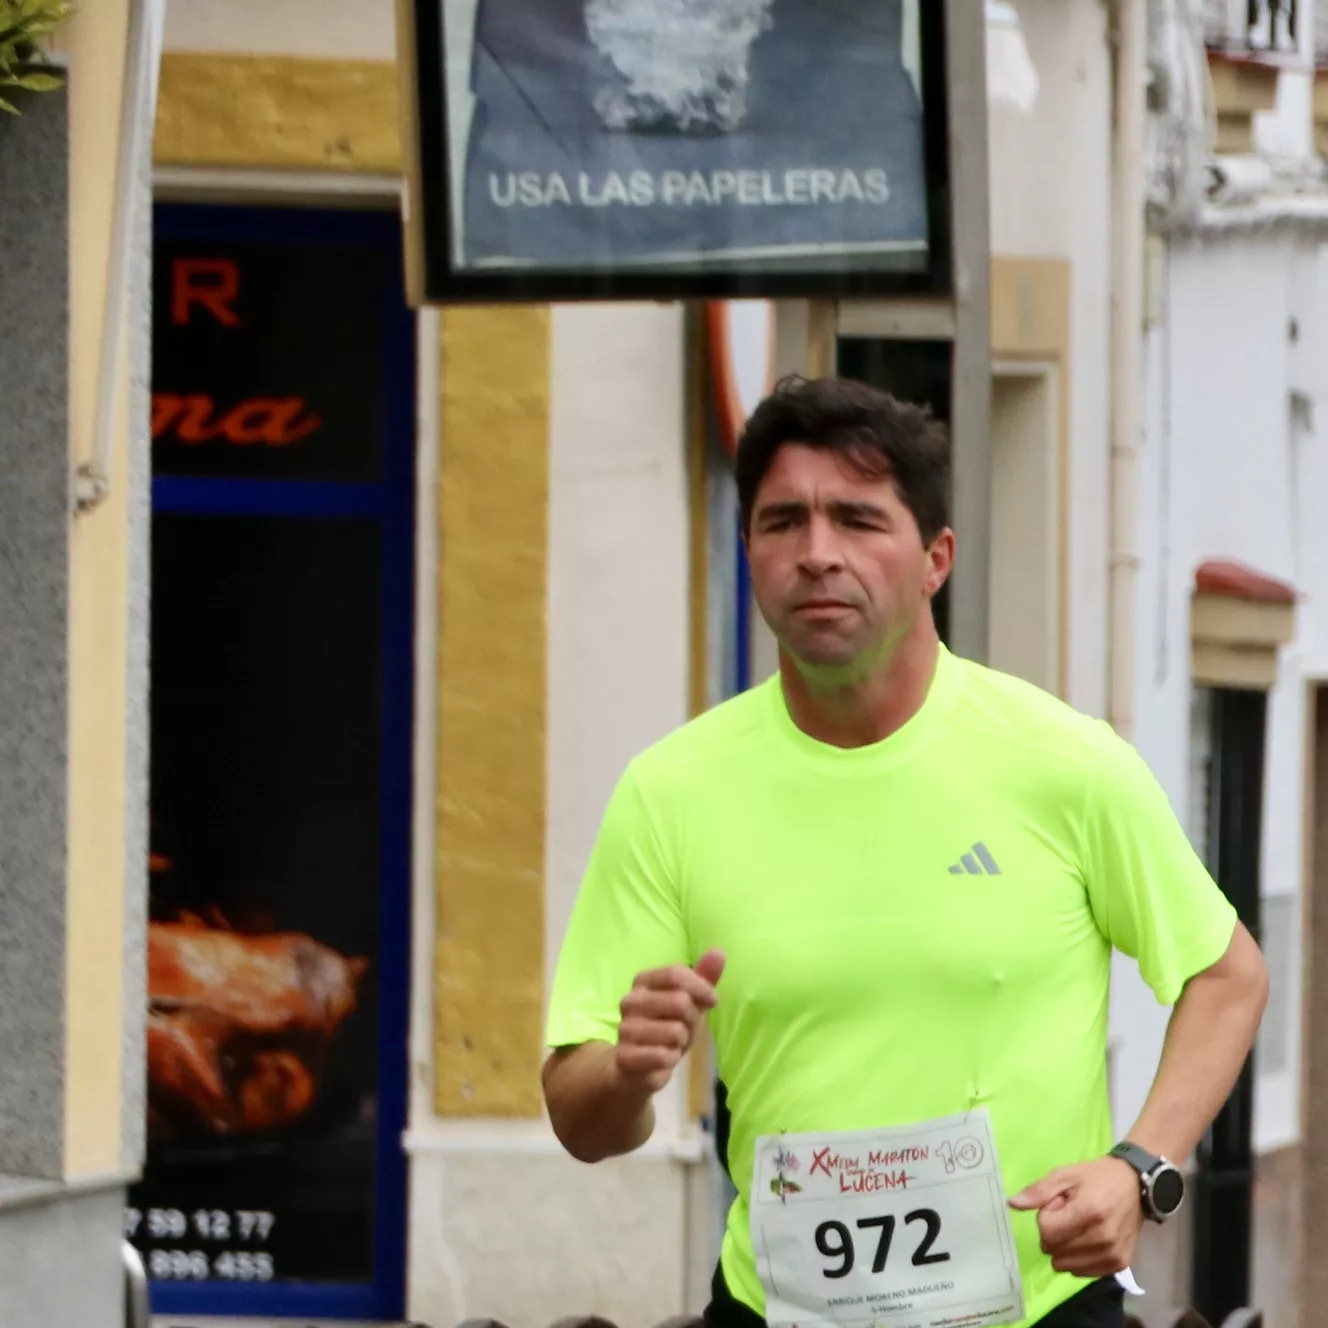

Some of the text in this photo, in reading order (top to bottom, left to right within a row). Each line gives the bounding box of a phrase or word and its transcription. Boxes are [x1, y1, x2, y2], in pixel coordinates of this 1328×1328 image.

[489, 168, 889, 206] USA LAS PAPELERAS
[193, 1208, 231, 1240] 12
[235, 1210, 275, 1241] 77
[814, 1207, 951, 1279] 972
